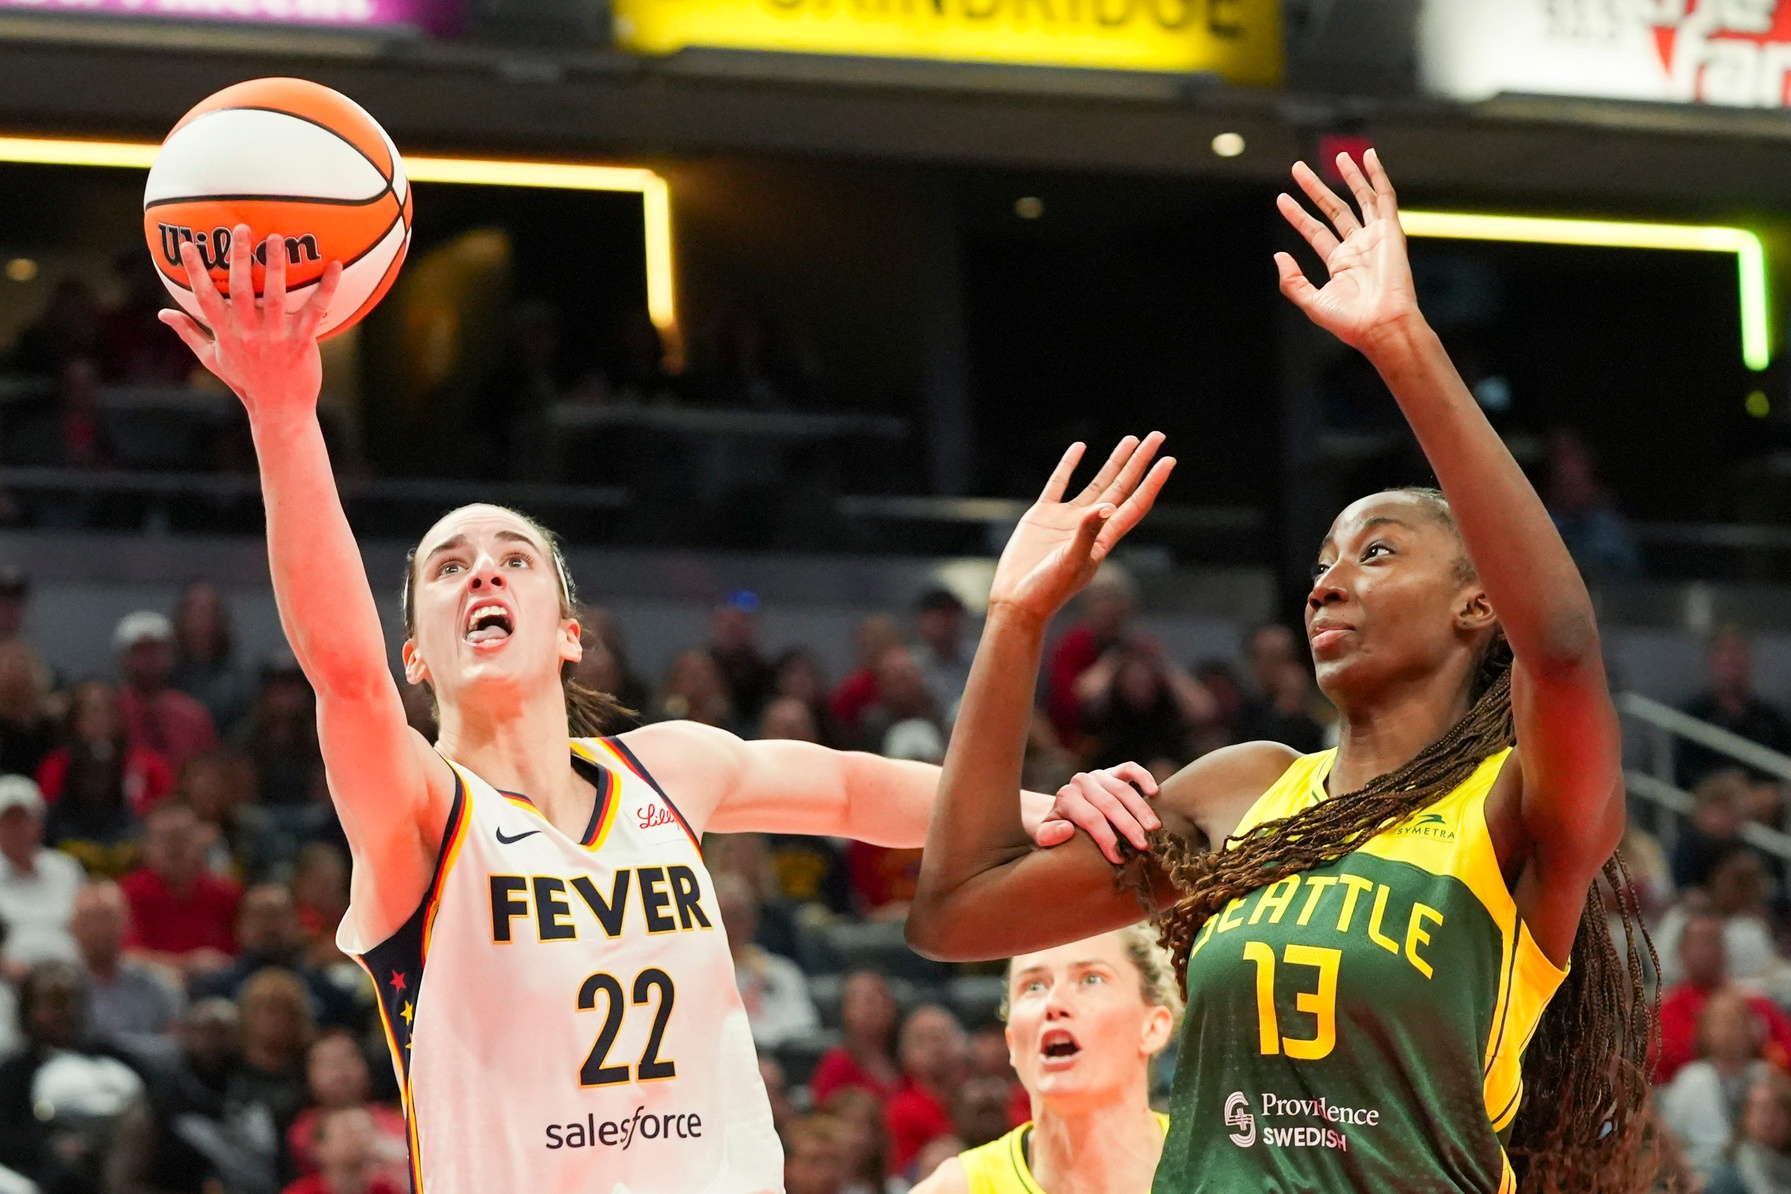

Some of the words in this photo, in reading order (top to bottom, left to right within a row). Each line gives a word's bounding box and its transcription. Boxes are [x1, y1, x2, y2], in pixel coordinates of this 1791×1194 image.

[158, 222, 322, 271] Wilon
[1396, 827, 1455, 840] SYMETRA
[488, 863, 714, 945] FEVER
[1242, 941, 1343, 1061] 13
[575, 966, 677, 1089] 22
[545, 1105, 702, 1151] salesforce
[1262, 1127, 1347, 1152] SWEDISH
